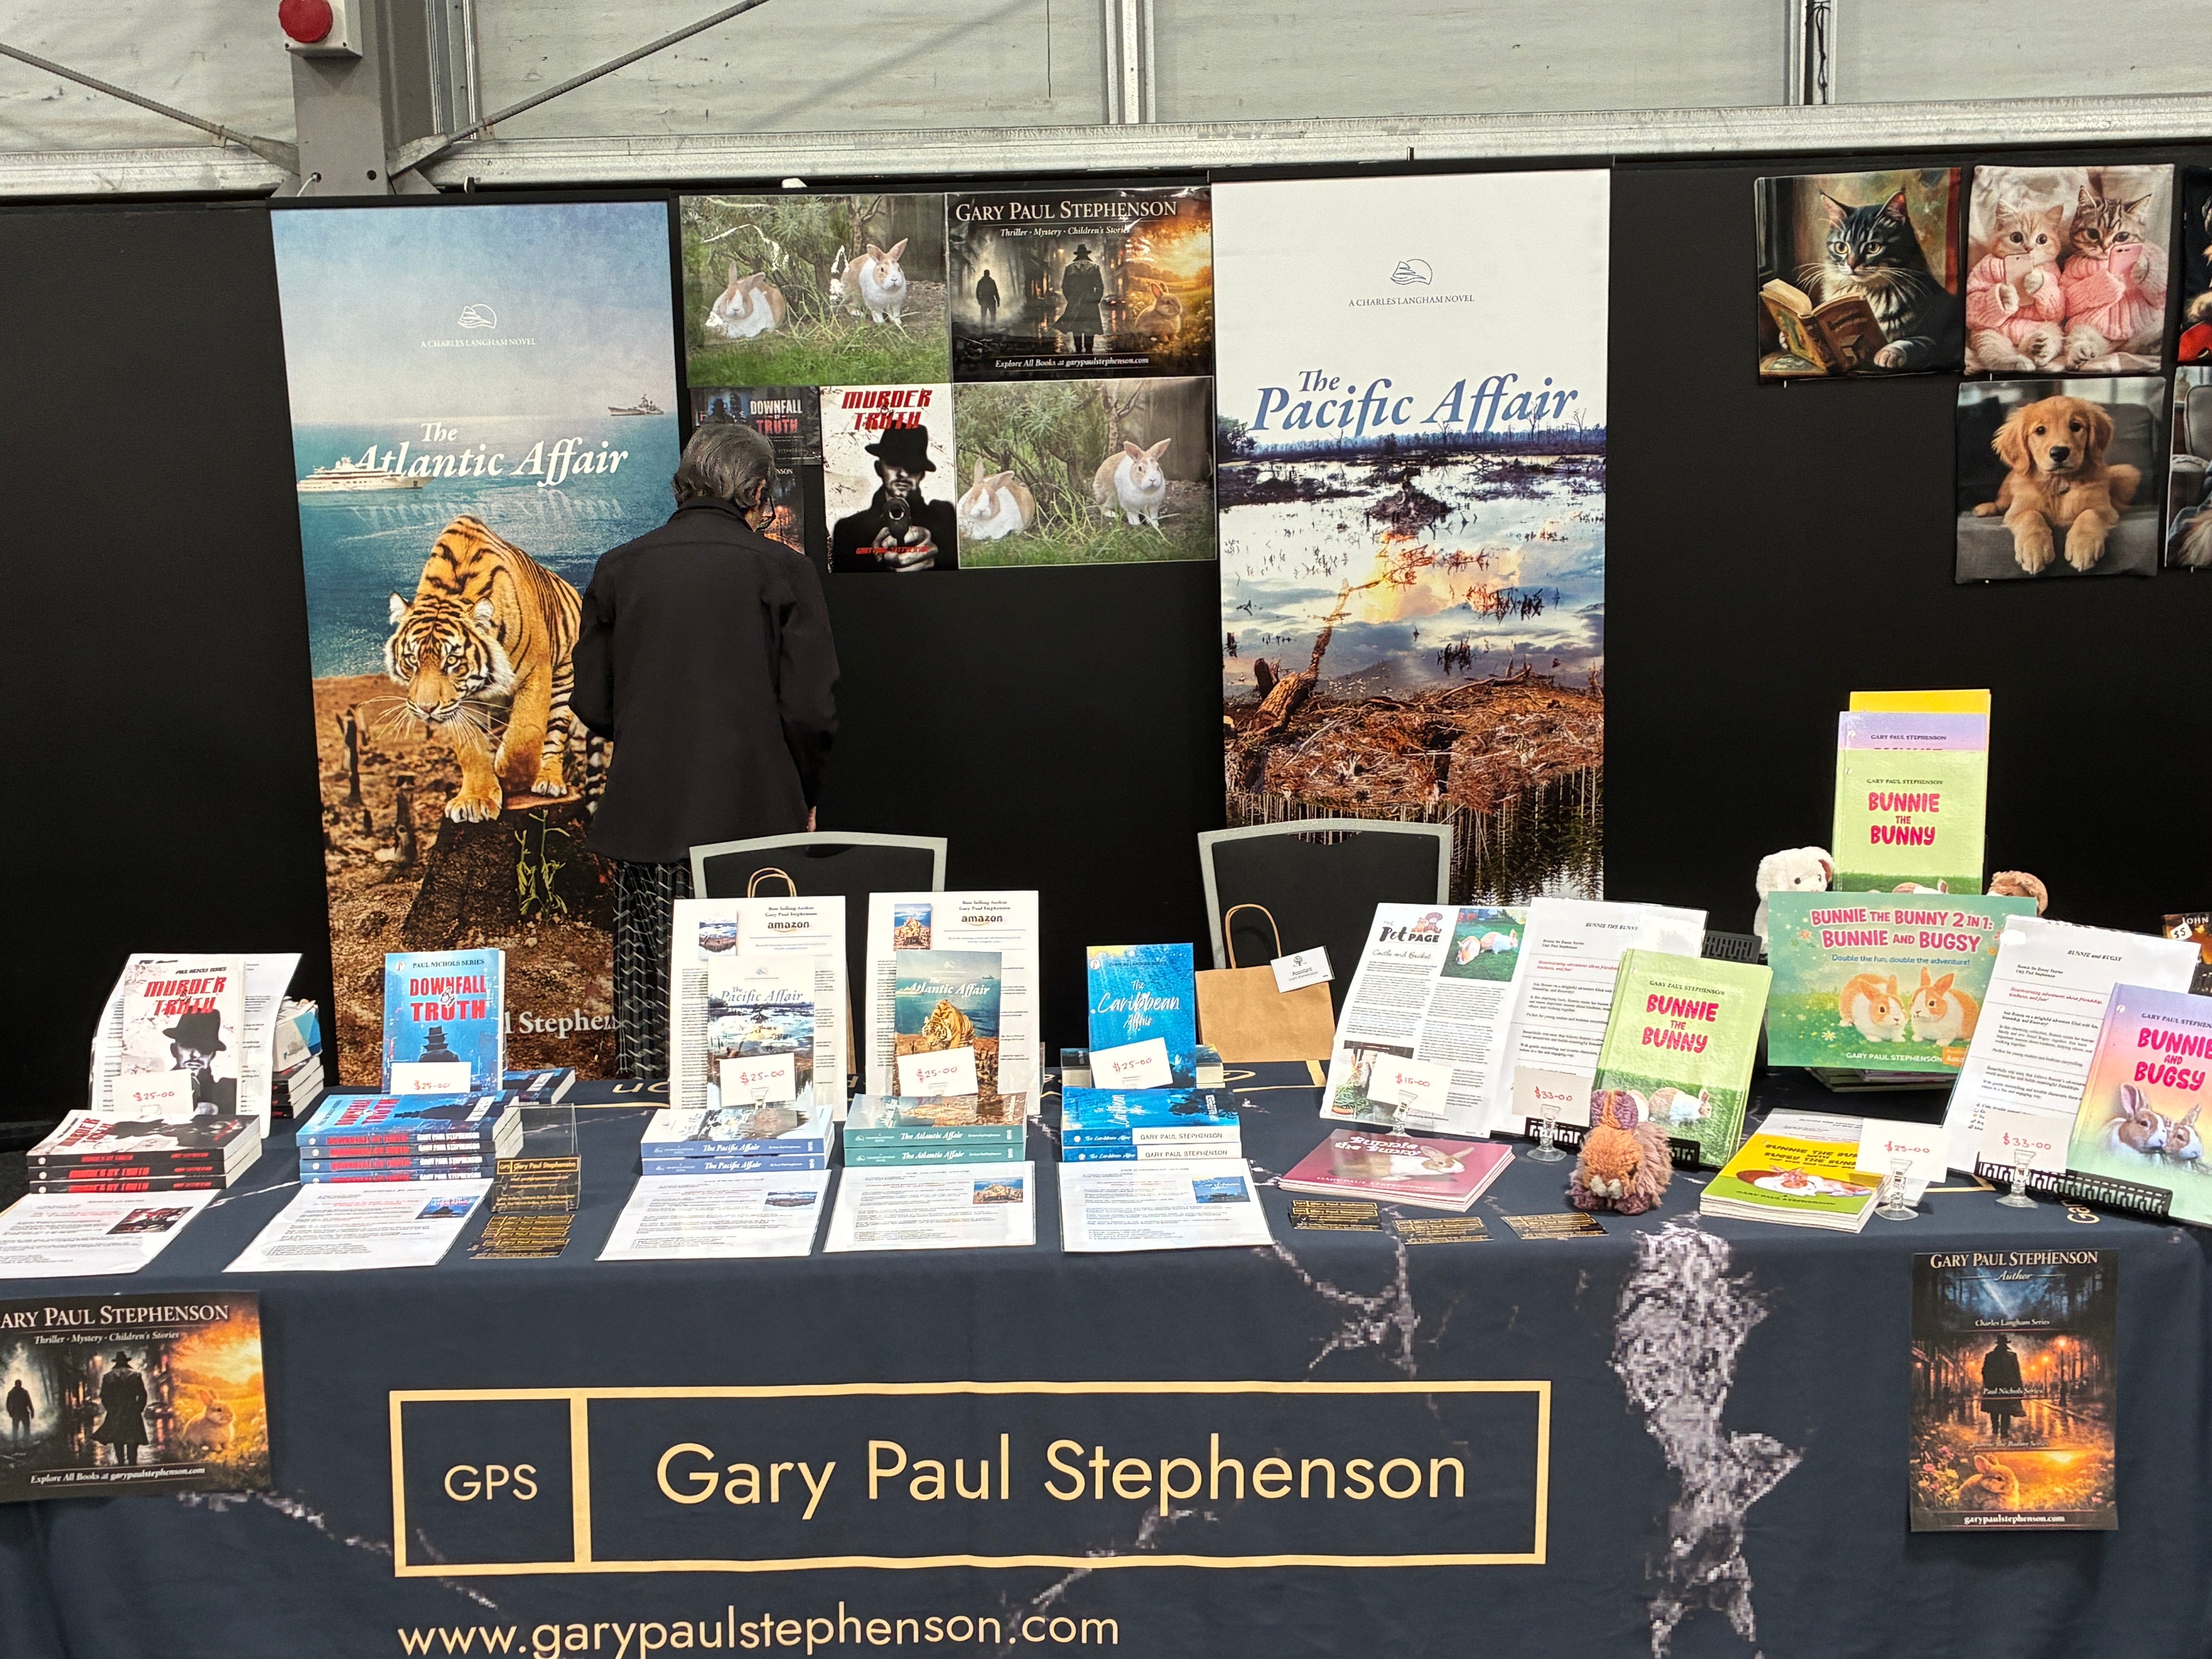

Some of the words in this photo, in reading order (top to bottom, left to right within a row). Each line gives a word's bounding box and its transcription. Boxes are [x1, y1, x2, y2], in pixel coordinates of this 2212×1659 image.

[956, 203, 1005, 221] GARY
[1009, 202, 1055, 220] PAUL
[1059, 199, 1177, 218] STEPHENSON
[1001, 228, 1028, 237] Thriller
[1033, 228, 1061, 238] Mystery
[1356, 298, 1396, 306] CHARLES
[1398, 296, 1443, 305] LANGHAM
[1444, 294, 1475, 303] NOVEL
[427, 339, 464, 348] CHARLES
[465, 339, 507, 347] LANGHAM
[508, 338, 536, 346] NOVEL
[995, 359, 1022, 369] Explore
[1035, 358, 1056, 366] Books
[1299, 369, 1340, 392] The
[750, 399, 803, 415] DOWNFALL
[842, 390, 933, 409] MURDER
[1248, 378, 1414, 437] Pacific
[1420, 373, 1578, 432] Affair
[756, 419, 798, 434] TRUTH
[854, 411, 922, 430] TRUTH
[421, 422, 457, 442] The
[355, 442, 505, 479] Atlantic
[512, 437, 629, 487] Affair
[1869, 791, 1940, 813] BUNNIE
[1895, 816, 1911, 824] THE
[1870, 825, 1936, 846] BUNNY
[767, 921, 809, 929] amazon
[1811, 908, 1866, 925] BUNNIE
[1870, 911, 1891, 922] THE
[1895, 910, 1949, 926] BUNNY
[1953, 912, 1965, 927] 2
[1967, 915, 1980, 927] IN
[1982, 916, 1993, 930] 1:
[1379, 926, 1407, 942] Pet
[1407, 933, 1440, 942] PAGE
[1822, 930, 1888, 948] BUNNIE
[1893, 934, 1915, 944] AND
[1919, 931, 1981, 952] BUGSY
[144, 976, 226, 997] MURDER
[410, 975, 486, 996] DOWNFALL
[908, 982, 954, 995] Atlantic
[955, 983, 990, 999] Affair
[1131, 979, 1146, 991] The
[721, 989, 762, 1004] Pacific
[764, 988, 803, 1003] Affair
[1097, 991, 1180, 1013] Caribbean
[154, 997, 216, 1016] TRUTH
[410, 999, 486, 1022] TRUTH
[1646, 994, 1719, 1022] BUNNIE
[1671, 1020, 1687, 1030] THE
[1642, 1027, 1709, 1054] BUNNY
[2138, 1028, 2212, 1059] BUNNIE
[1112, 1058, 1152, 1073] $25-00
[1891, 1054, 1942, 1062] STEPHENSON
[2164, 1054, 2183, 1065] AND
[740, 1070, 785, 1085] $25-00
[916, 1066, 957, 1083] $25-00
[2134, 1062, 2206, 1091] BUGSY
[414, 1080, 451, 1090] $25-00
[1535, 1086, 1573, 1101] $33-00
[133, 1091, 175, 1101] $25-00
[1884, 1140, 1930, 1153] $25-00
[2003, 1132, 2051, 1150] $33-00
[1930, 1253, 1968, 1269] GARY
[1973, 1253, 2006, 1267] PAUL
[2009, 1251, 2099, 1266] STEPHENSON
[1994, 1270, 2033, 1281] Author
[0, 1312, 38, 1329] ARY
[44, 1307, 95, 1326] PAUL
[100, 1305, 229, 1325] STEPHENSON
[35, 1335, 65, 1345] Thriller
[71, 1334, 103, 1344] Mystery
[109, 1331, 150, 1342] Children's
[152, 1331, 180, 1339] Stories
[31, 1474, 61, 1484] Explore
[63, 1472, 74, 1481] All
[76, 1472, 100, 1481] Books
[445, 1463, 538, 1502] GPS
[657, 1442, 836, 1520] Gary
[868, 1433, 1009, 1501] Paul
[1044, 1432, 1465, 1517] Stephenson
[1964, 1514, 2065, 1525] garypaulstephenson.com
[399, 1601, 1120, 1659] www.garypaulstephenson.com
